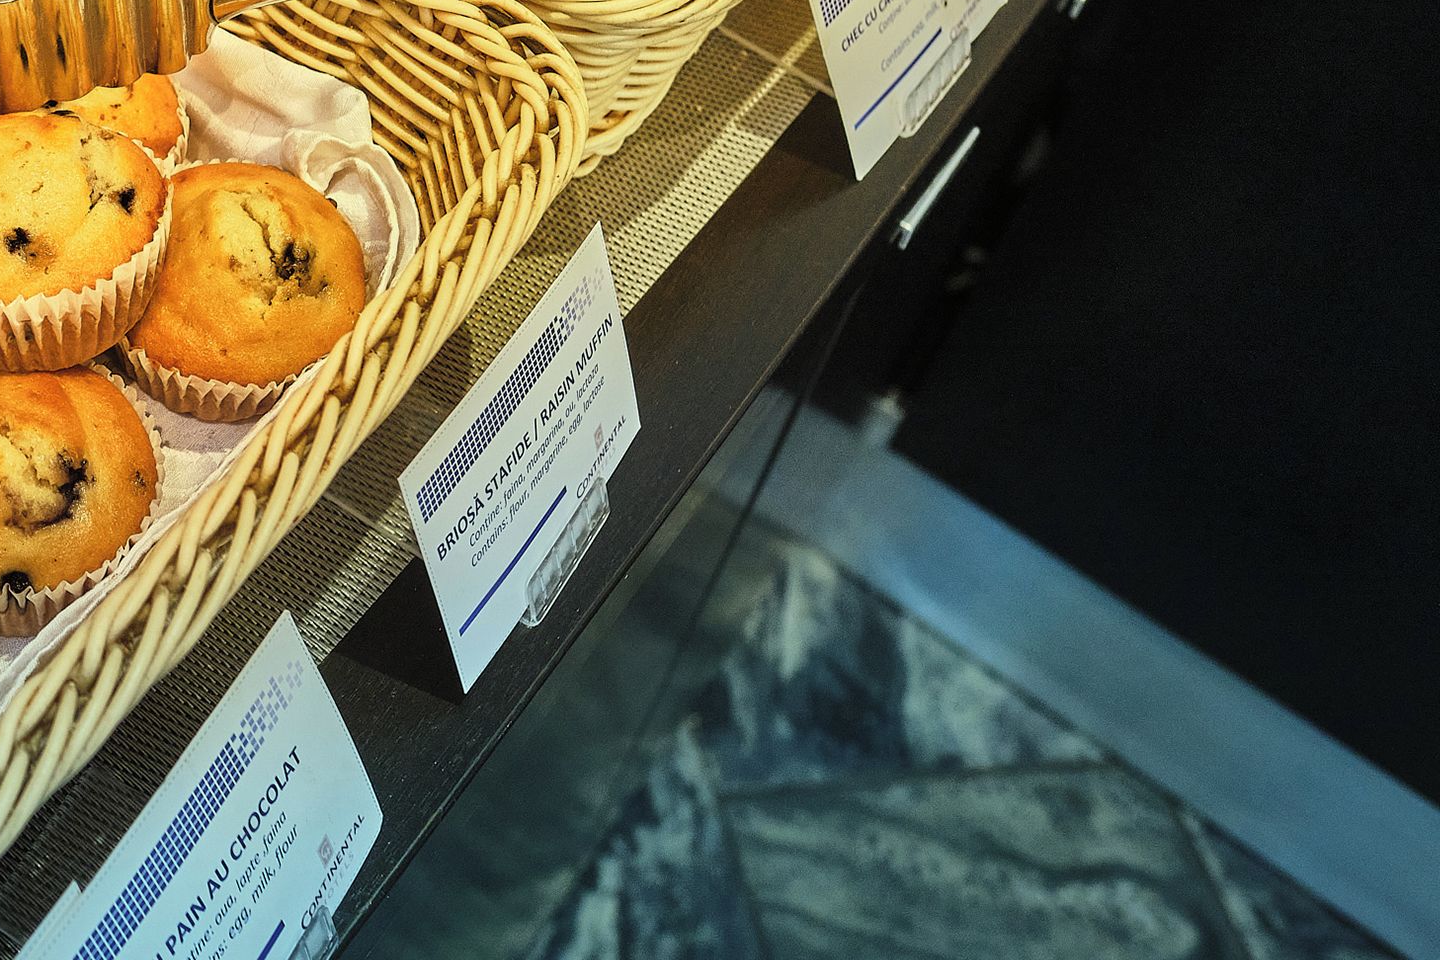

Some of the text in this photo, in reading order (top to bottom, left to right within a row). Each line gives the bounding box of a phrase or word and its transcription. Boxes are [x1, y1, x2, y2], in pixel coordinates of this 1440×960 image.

[841, 21, 865, 52] CHEC
[864, 7, 878, 27] CU
[484, 431, 533, 501] STAFIDE
[540, 370, 576, 426] RAISIN
[575, 312, 613, 375] MUFFIN
[503, 472, 526, 508] faina,
[525, 418, 565, 473] margarina,
[565, 401, 576, 418] ou,
[576, 363, 599, 400] lactoza
[576, 415, 627, 499] CONTINENTAL
[471, 375, 605, 567] Contains: flour, margarine, egg, lactose
[165, 745, 301, 957] PAIN AU CHOCOLAT
[215, 895, 237, 926] oua,
[235, 853, 261, 893] lapte
[228, 906, 252, 940] egg,
[251, 867, 276, 903] milk,
[274, 824, 298, 869] flour
[301, 814, 365, 929] CONTINENTAL
